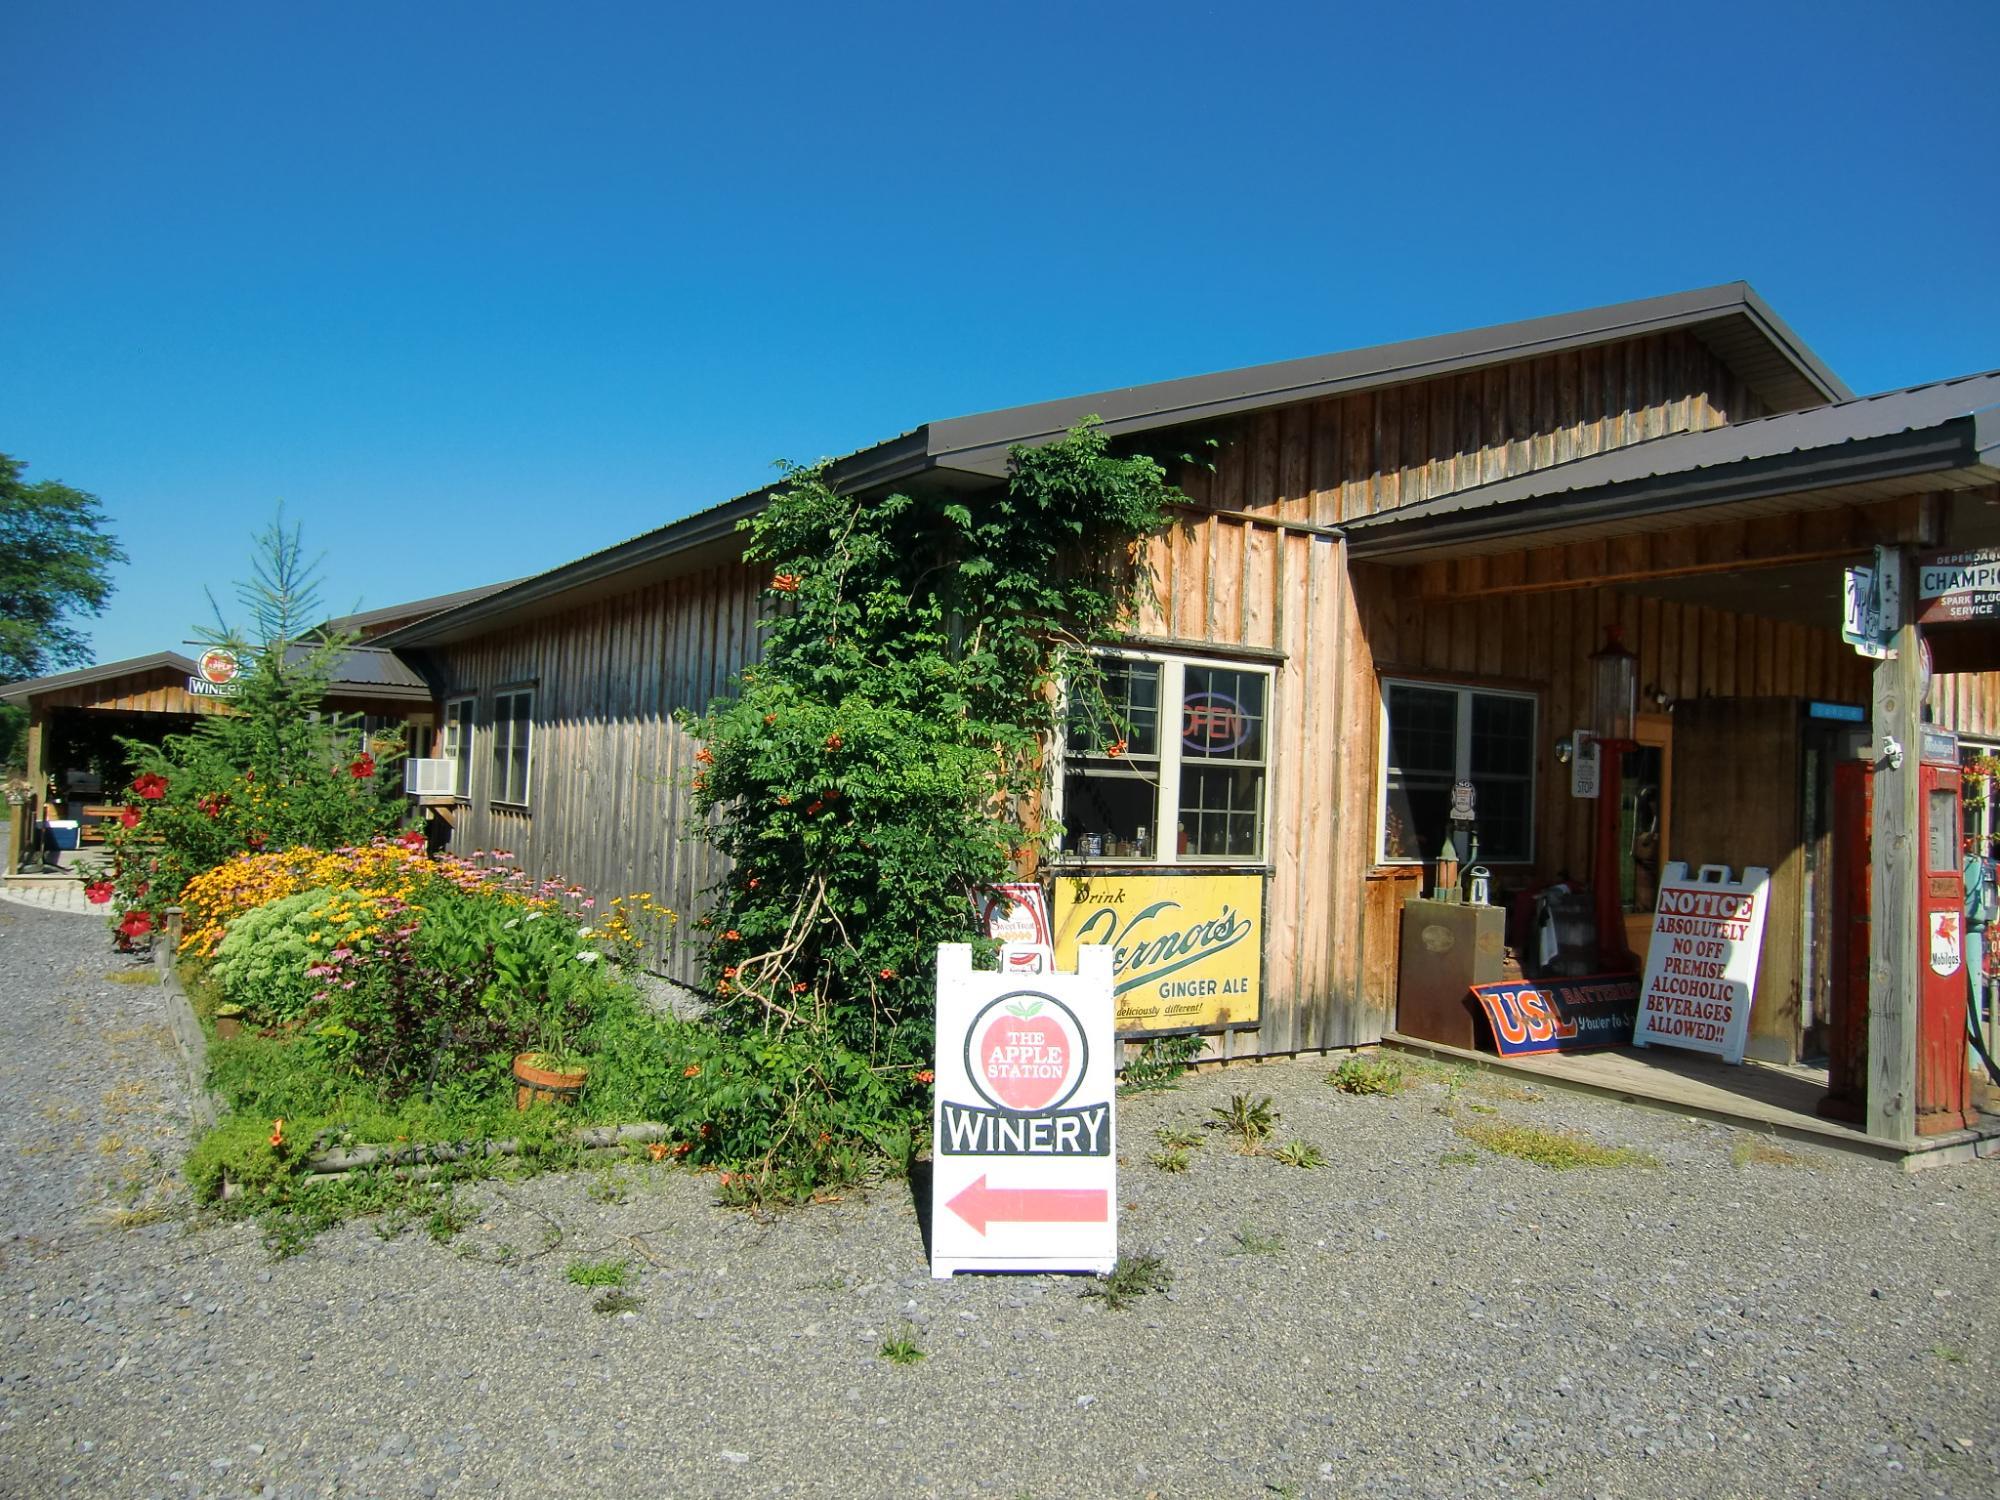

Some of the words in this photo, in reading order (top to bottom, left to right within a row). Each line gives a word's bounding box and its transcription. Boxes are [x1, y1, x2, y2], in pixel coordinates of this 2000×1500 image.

[1941, 595, 1972, 606] SPARK
[1950, 604, 1993, 616] SERVICE
[192, 679, 245, 696] WINE
[1183, 704, 1242, 739] OPEN
[1578, 781, 1593, 794] STOP
[1071, 888, 1126, 904] Drink
[1660, 890, 1752, 918] NOTICE
[1656, 917, 1749, 941] ABSOLUTELY
[1076, 900, 1252, 979] Vernor's
[1672, 938, 1694, 955] NO
[1696, 941, 1724, 959] OFF
[1663, 957, 1725, 980] PREMISE
[1932, 952, 1959, 968] Mobilgas
[1159, 980, 1217, 998] GINGER
[1222, 978, 1249, 994] ALE
[1651, 976, 1733, 1001] ALCOHOLIC
[1116, 1004, 1160, 1017] deliciously
[1164, 1003, 1203, 1015] different!
[1481, 990, 1578, 1044] USL
[1646, 994, 1732, 1022] BEVERAGES
[1007, 1032, 1045, 1046] THE
[1646, 1015, 1725, 1043] ALLOWED!!
[988, 1046, 1063, 1064] APPLE
[988, 1064, 1063, 1079] STATION
[944, 1106, 1107, 1152] WINERY
